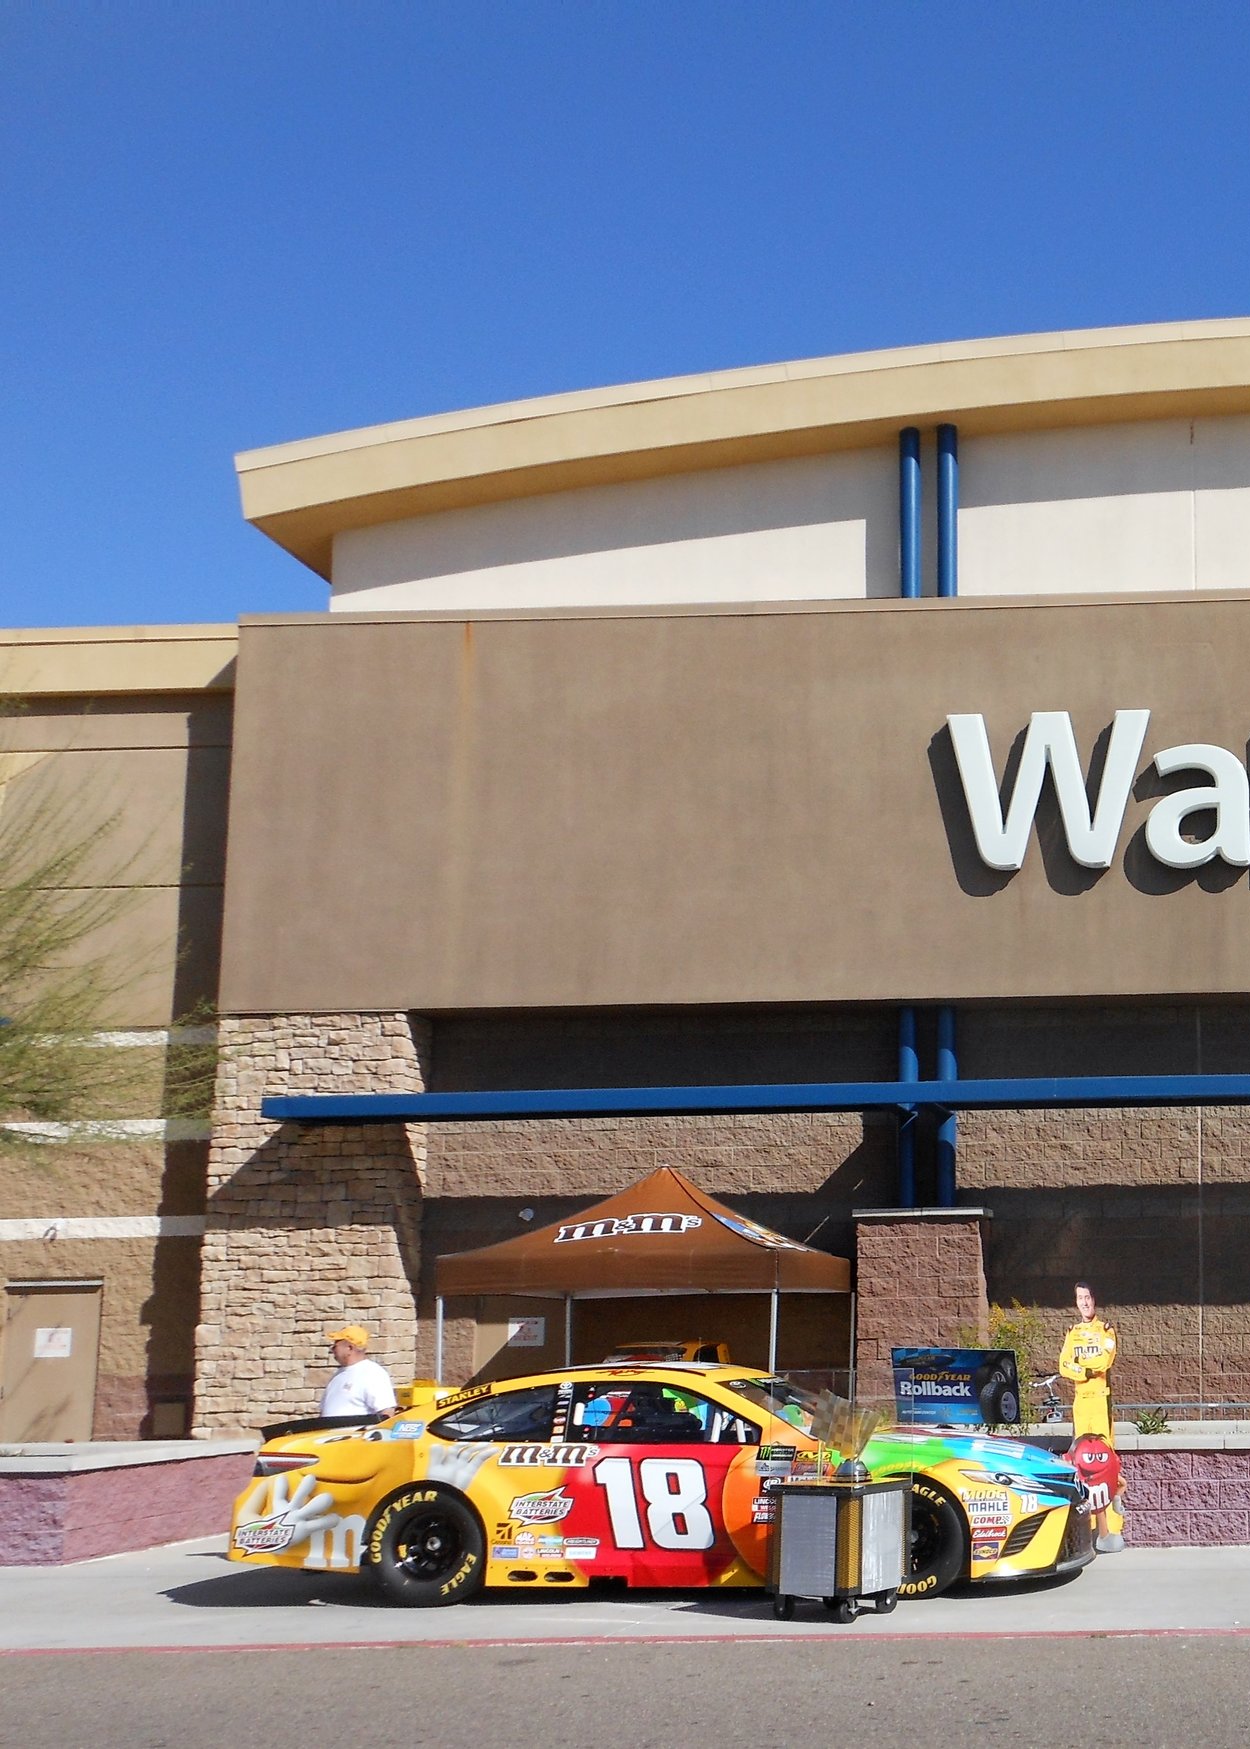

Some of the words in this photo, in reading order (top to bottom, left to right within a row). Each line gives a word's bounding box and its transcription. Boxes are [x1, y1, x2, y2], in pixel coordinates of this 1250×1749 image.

[438, 1384, 490, 1407] STANLEY
[900, 1381, 973, 1397] Rollback
[592, 1456, 716, 1550] 18
[910, 1483, 947, 1507] AGLE
[962, 1490, 1008, 1501] MOOG
[968, 1501, 1009, 1513] MAHLE
[1019, 1493, 1038, 1514] 18
[238, 1530, 290, 1538] INTERSTATE
[239, 1536, 287, 1545] BATTERIES
[973, 1529, 1006, 1539] Edelbrock
[440, 1552, 477, 1596] EAGLE
